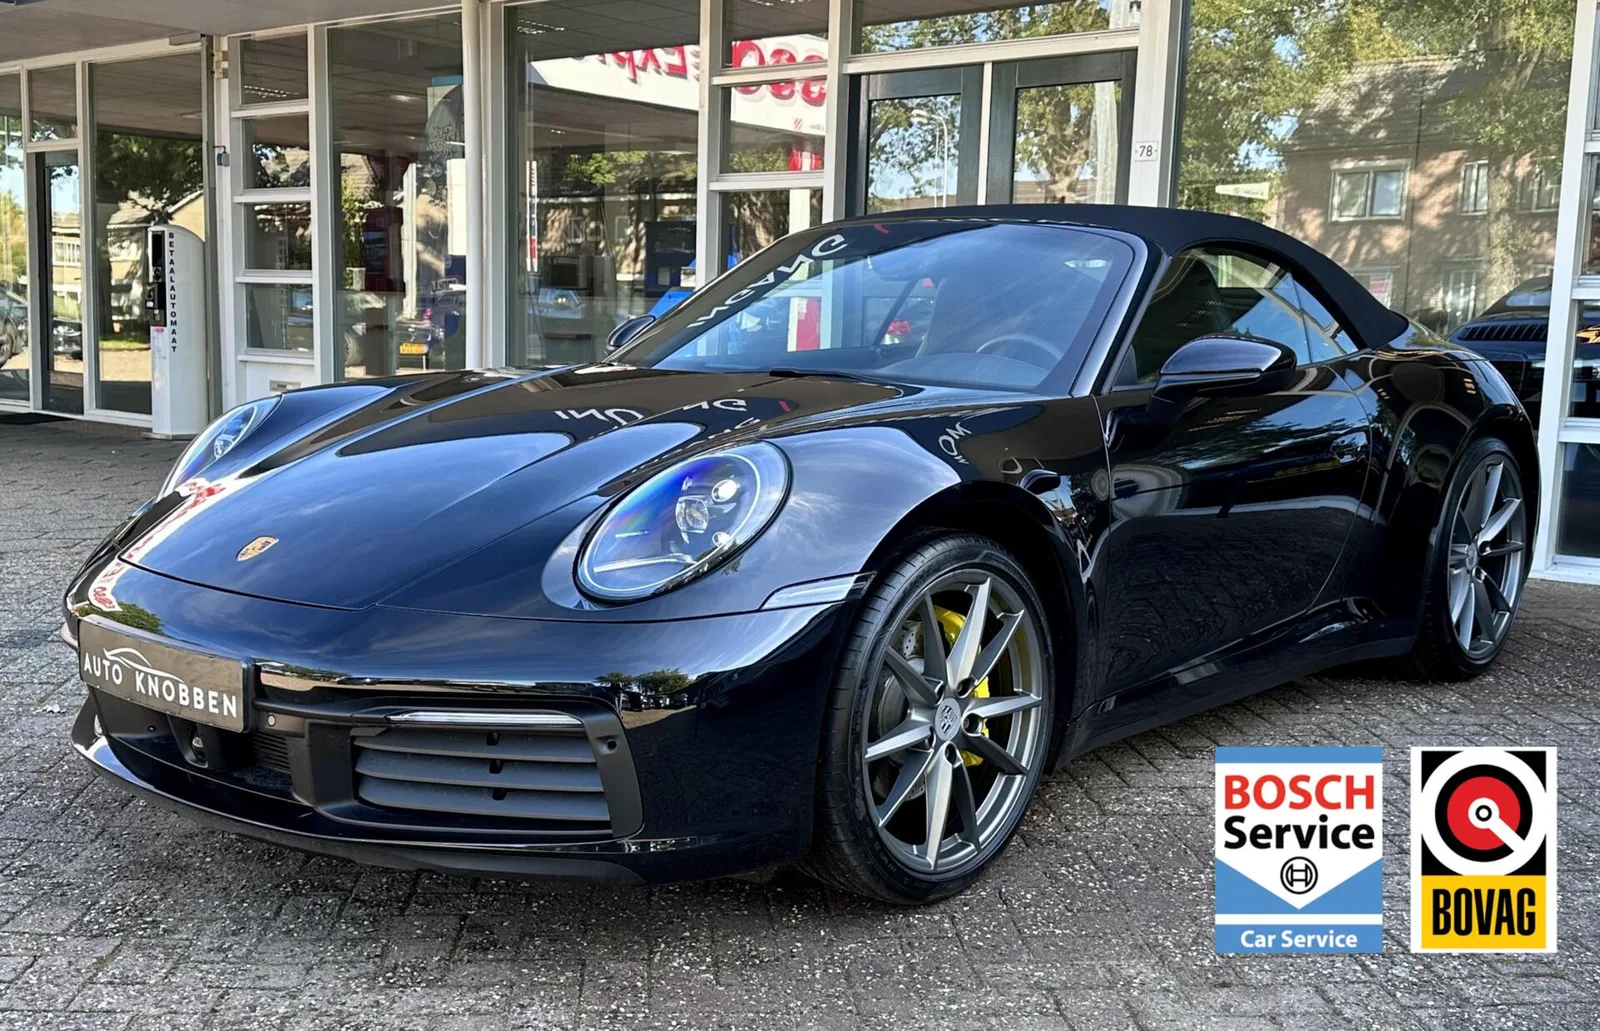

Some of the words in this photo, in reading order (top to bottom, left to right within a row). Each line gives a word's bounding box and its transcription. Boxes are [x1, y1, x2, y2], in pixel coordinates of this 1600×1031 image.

[1139, 145, 1153, 157] 78
[168, 232, 177, 352] BETAALAUTOMAAT
[83, 652, 123, 685] AUTO
[135, 670, 237, 718] KNOBBEN
